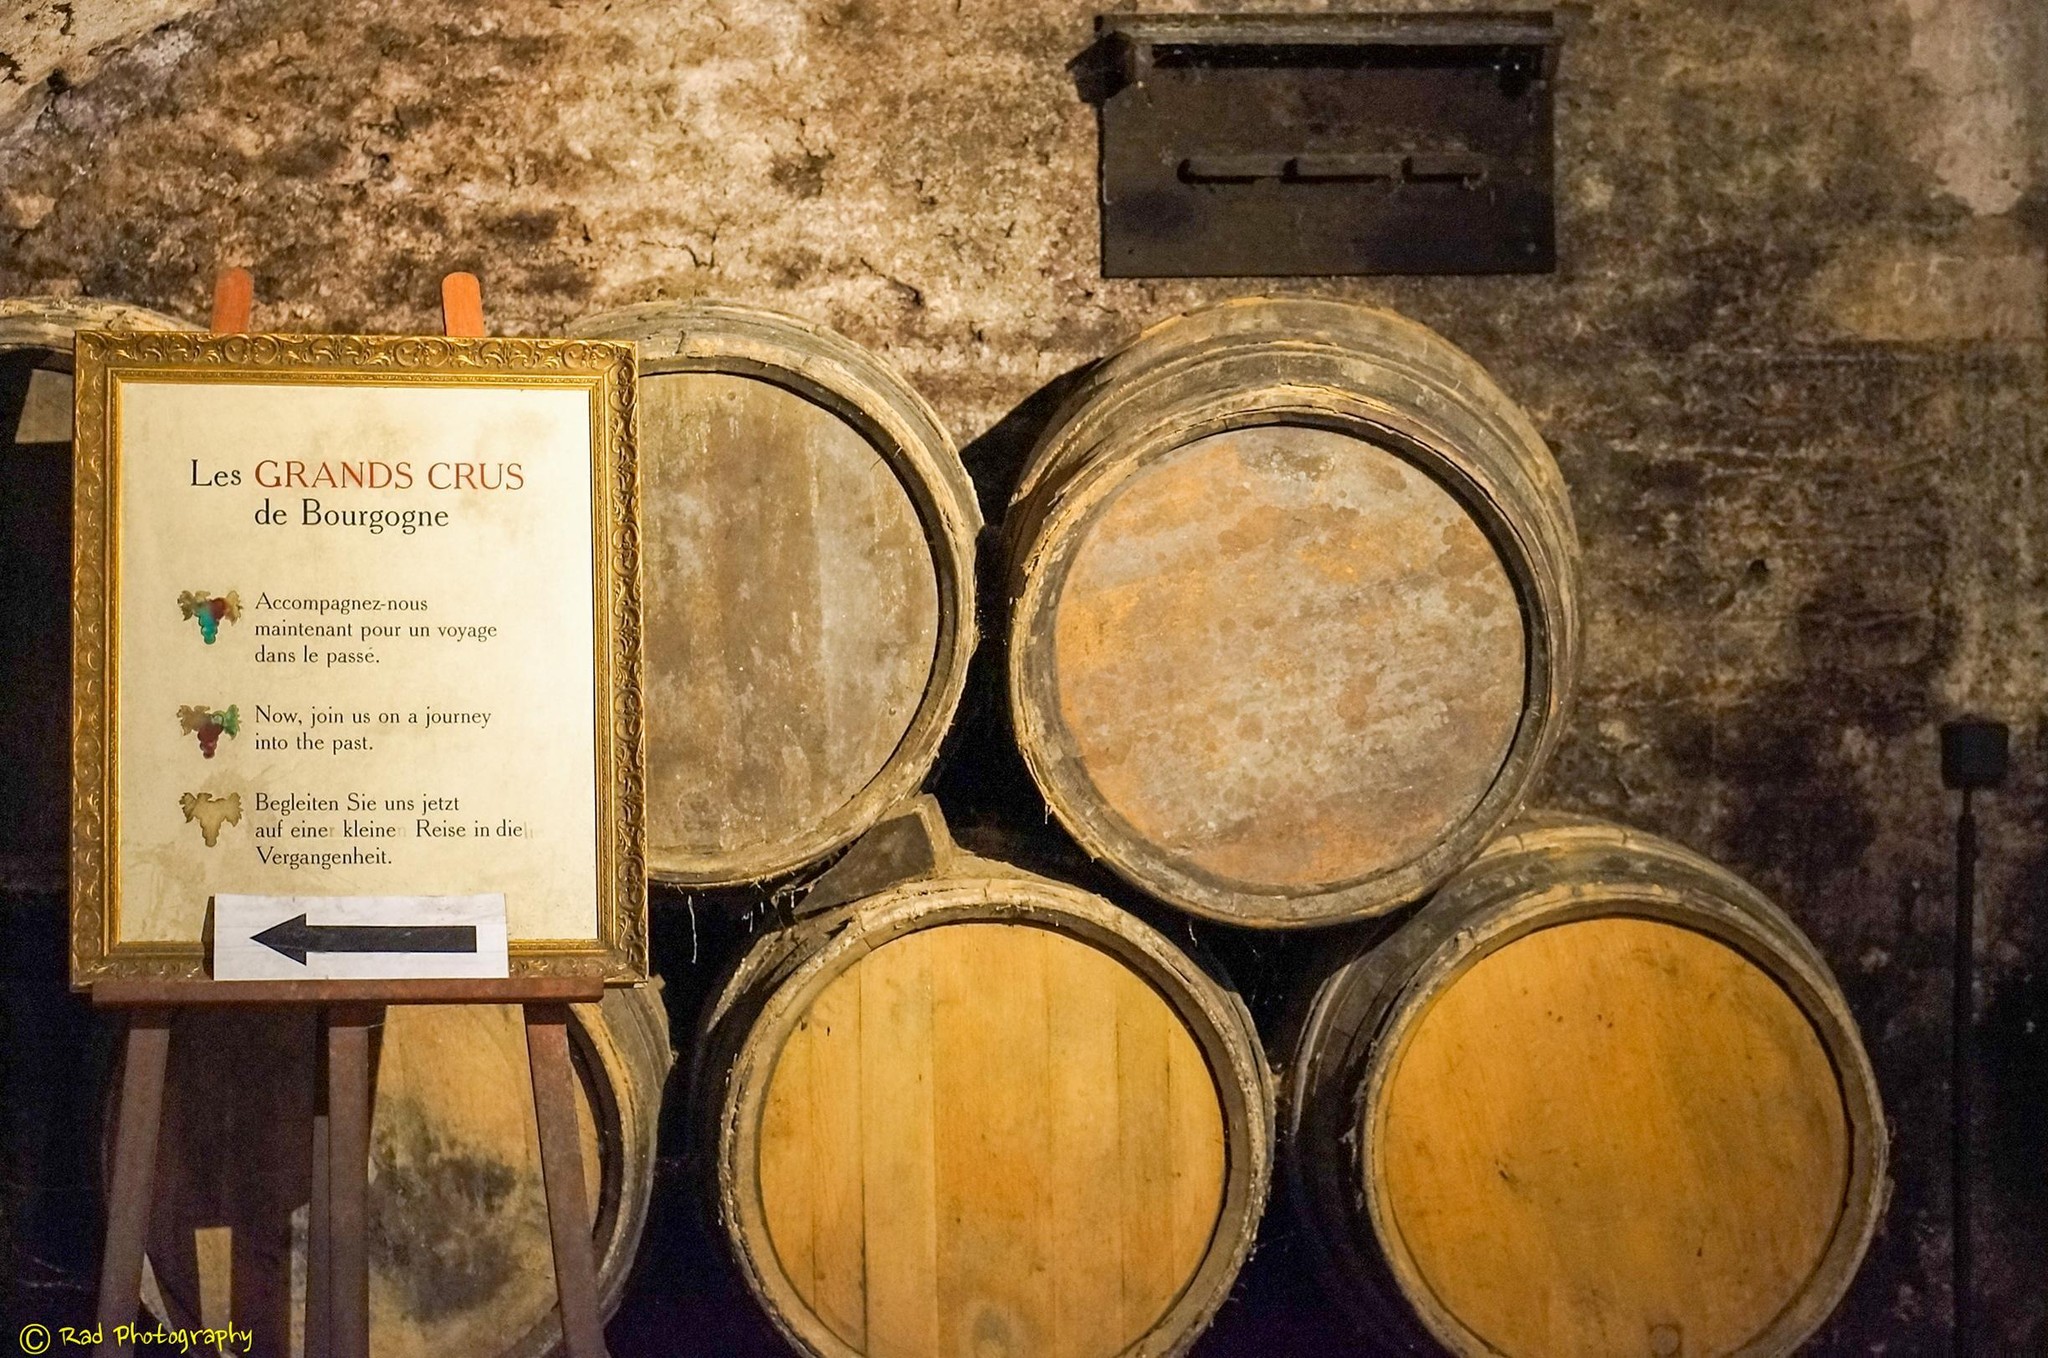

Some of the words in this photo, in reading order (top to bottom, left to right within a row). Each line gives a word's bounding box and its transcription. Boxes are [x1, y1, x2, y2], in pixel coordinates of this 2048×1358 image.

[190, 458, 242, 488] Les
[254, 459, 414, 490] GRANDS
[427, 462, 524, 491] CRUS
[254, 497, 288, 526] de
[301, 497, 449, 536] Bourgogne
[254, 591, 428, 614] Accompagnez-nous
[254, 618, 353, 639] maintenant
[360, 625, 402, 641] pour
[408, 625, 430, 638] un
[436, 625, 497, 641] voyage
[254, 643, 297, 664] dans
[303, 643, 319, 664] le
[326, 646, 380, 668] passé.
[255, 704, 303, 727] Now,
[309, 705, 344, 730] join
[351, 712, 371, 725] us
[378, 712, 401, 725] on
[407, 712, 419, 725] a
[424, 705, 492, 730] journey
[255, 731, 289, 751] into
[296, 731, 325, 751] the
[332, 736, 374, 756] past.
[255, 792, 340, 816] Begleiten
[346, 791, 377, 812] Sie
[384, 799, 415, 812] uns
[421, 793, 460, 817] jetzt
[254, 819, 284, 839] auf
[415, 818, 467, 838] Reise
[474, 819, 490, 838] in
[255, 845, 392, 871] Vergangenheit.
